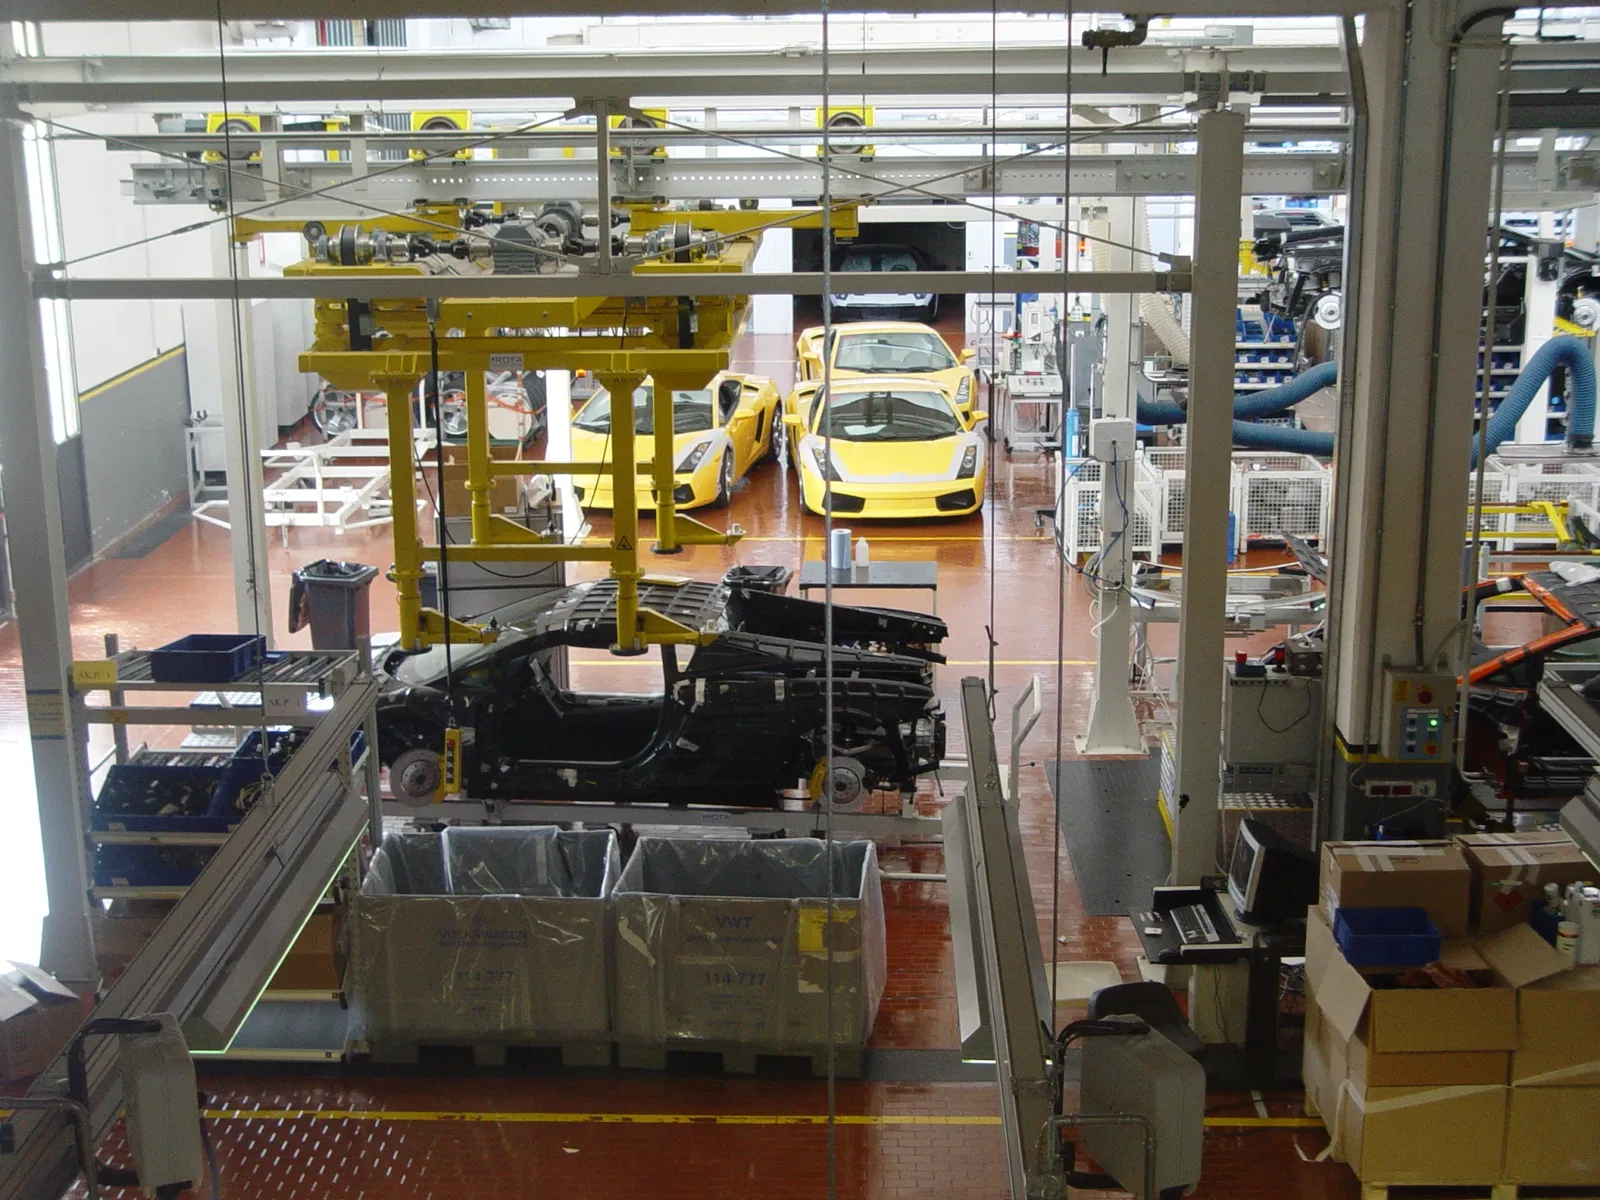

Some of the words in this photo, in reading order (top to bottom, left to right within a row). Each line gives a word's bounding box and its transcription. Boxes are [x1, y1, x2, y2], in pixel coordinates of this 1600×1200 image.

[715, 916, 752, 928] VWT
[704, 972, 731, 985] 114
[738, 972, 766, 985] 777
